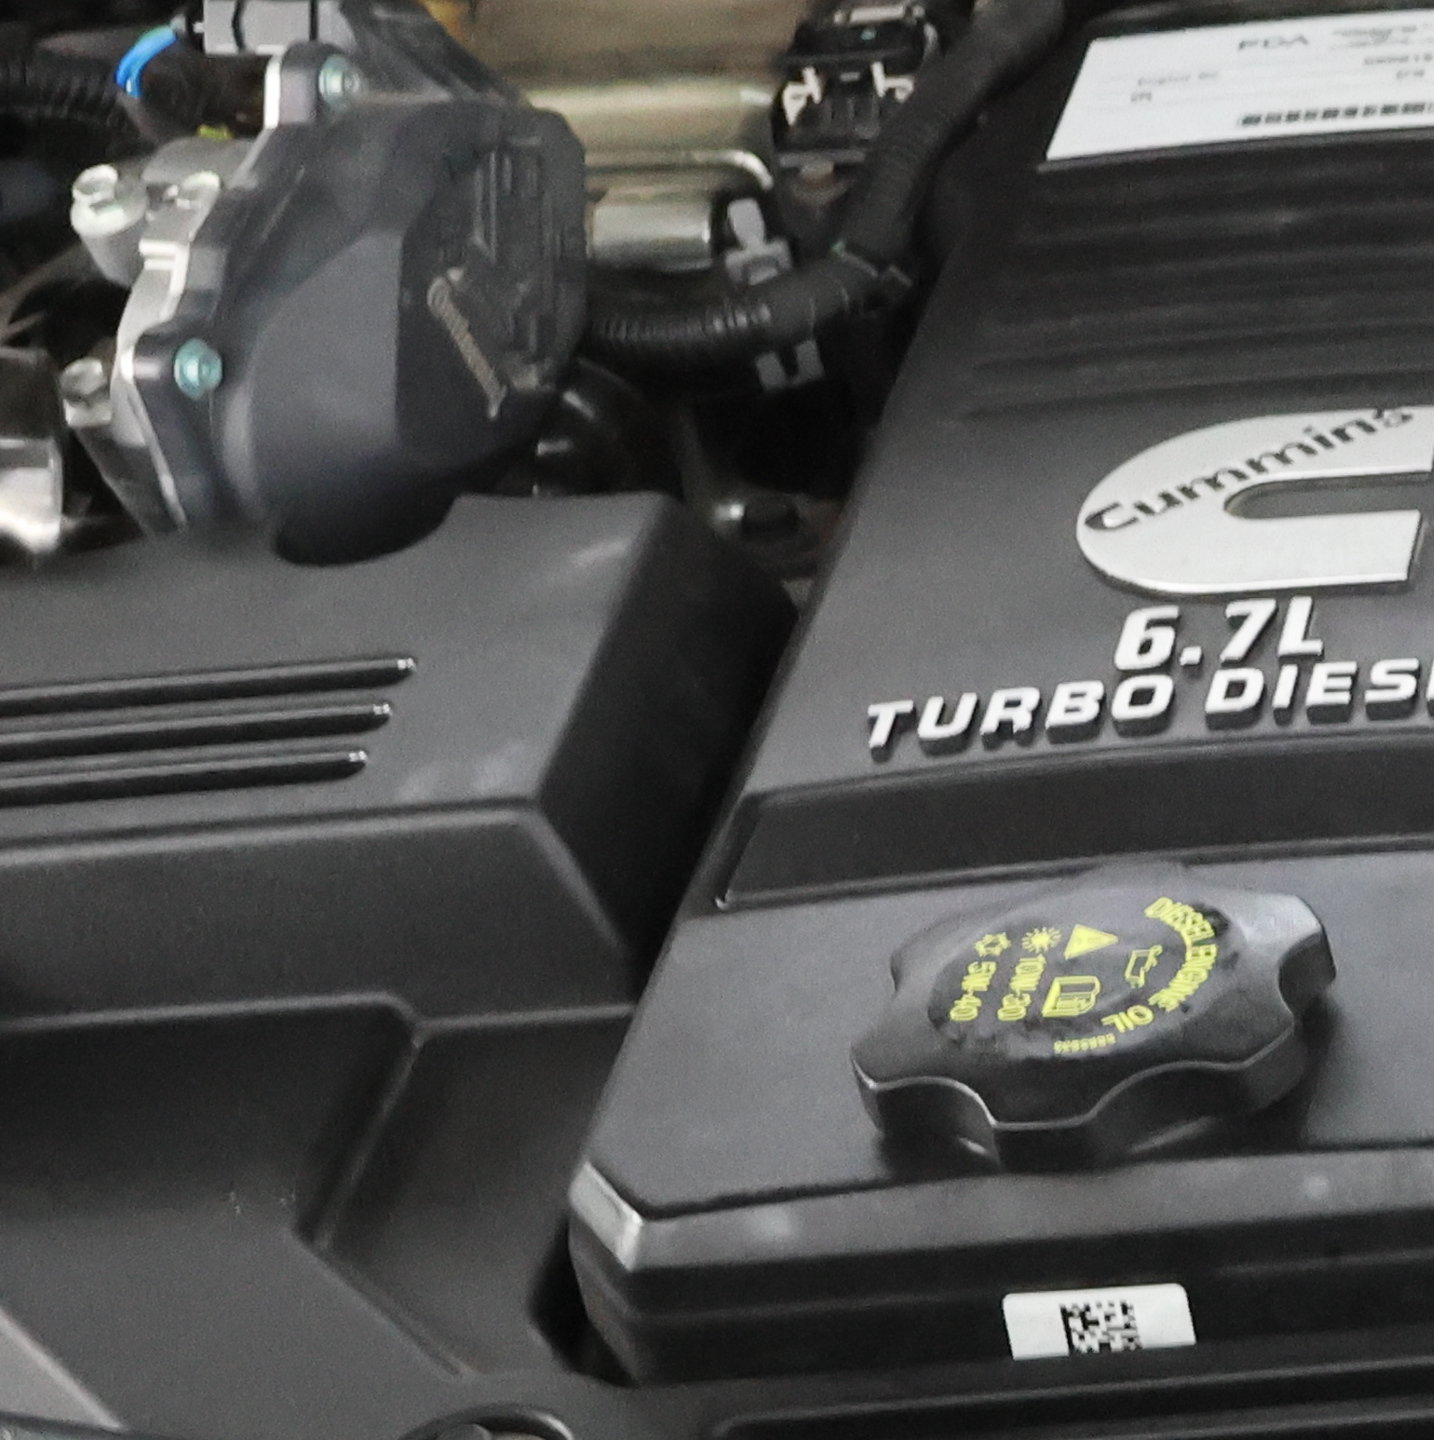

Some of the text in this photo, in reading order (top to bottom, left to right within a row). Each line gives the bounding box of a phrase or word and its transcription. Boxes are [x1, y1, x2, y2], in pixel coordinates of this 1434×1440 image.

[1085, 408, 1413, 531] Cummins
[1114, 596, 1323, 670] 6.7L
[867, 674, 1176, 750] TURBO
[950, 961, 997, 1021] 5W-40
[998, 954, 1046, 1021] 10W-30
[1101, 897, 1218, 1033] DIESEL ENGINE OIL
